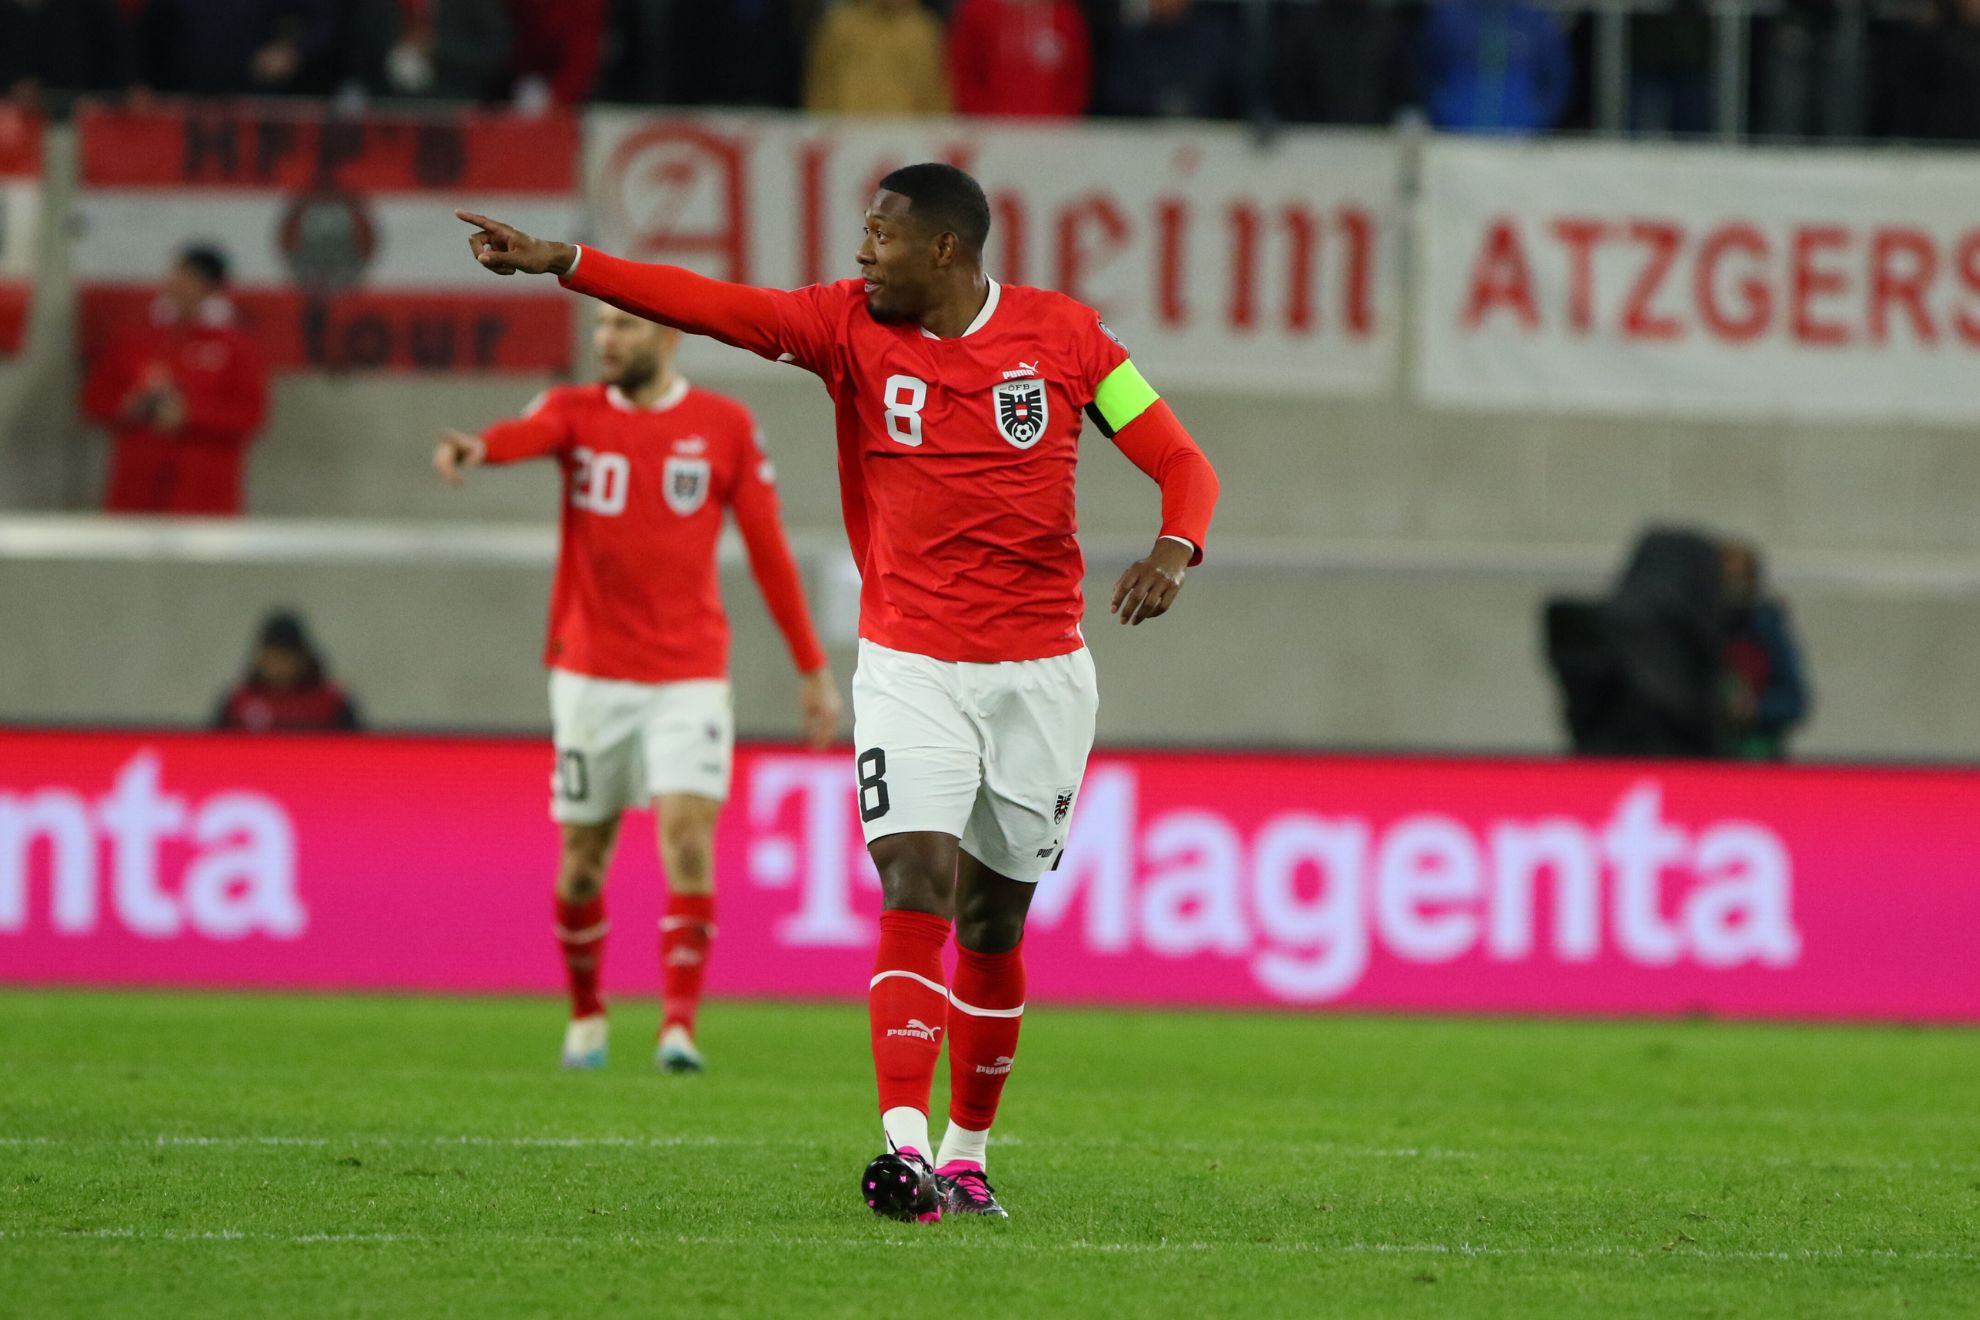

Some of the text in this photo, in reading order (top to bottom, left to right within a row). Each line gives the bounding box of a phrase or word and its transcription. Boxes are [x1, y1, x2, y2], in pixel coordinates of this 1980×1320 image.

[883, 374, 928, 447] 8
[1007, 383, 1030, 391] ÖFB
[571, 446, 630, 518] 20
[857, 747, 890, 824] 8
